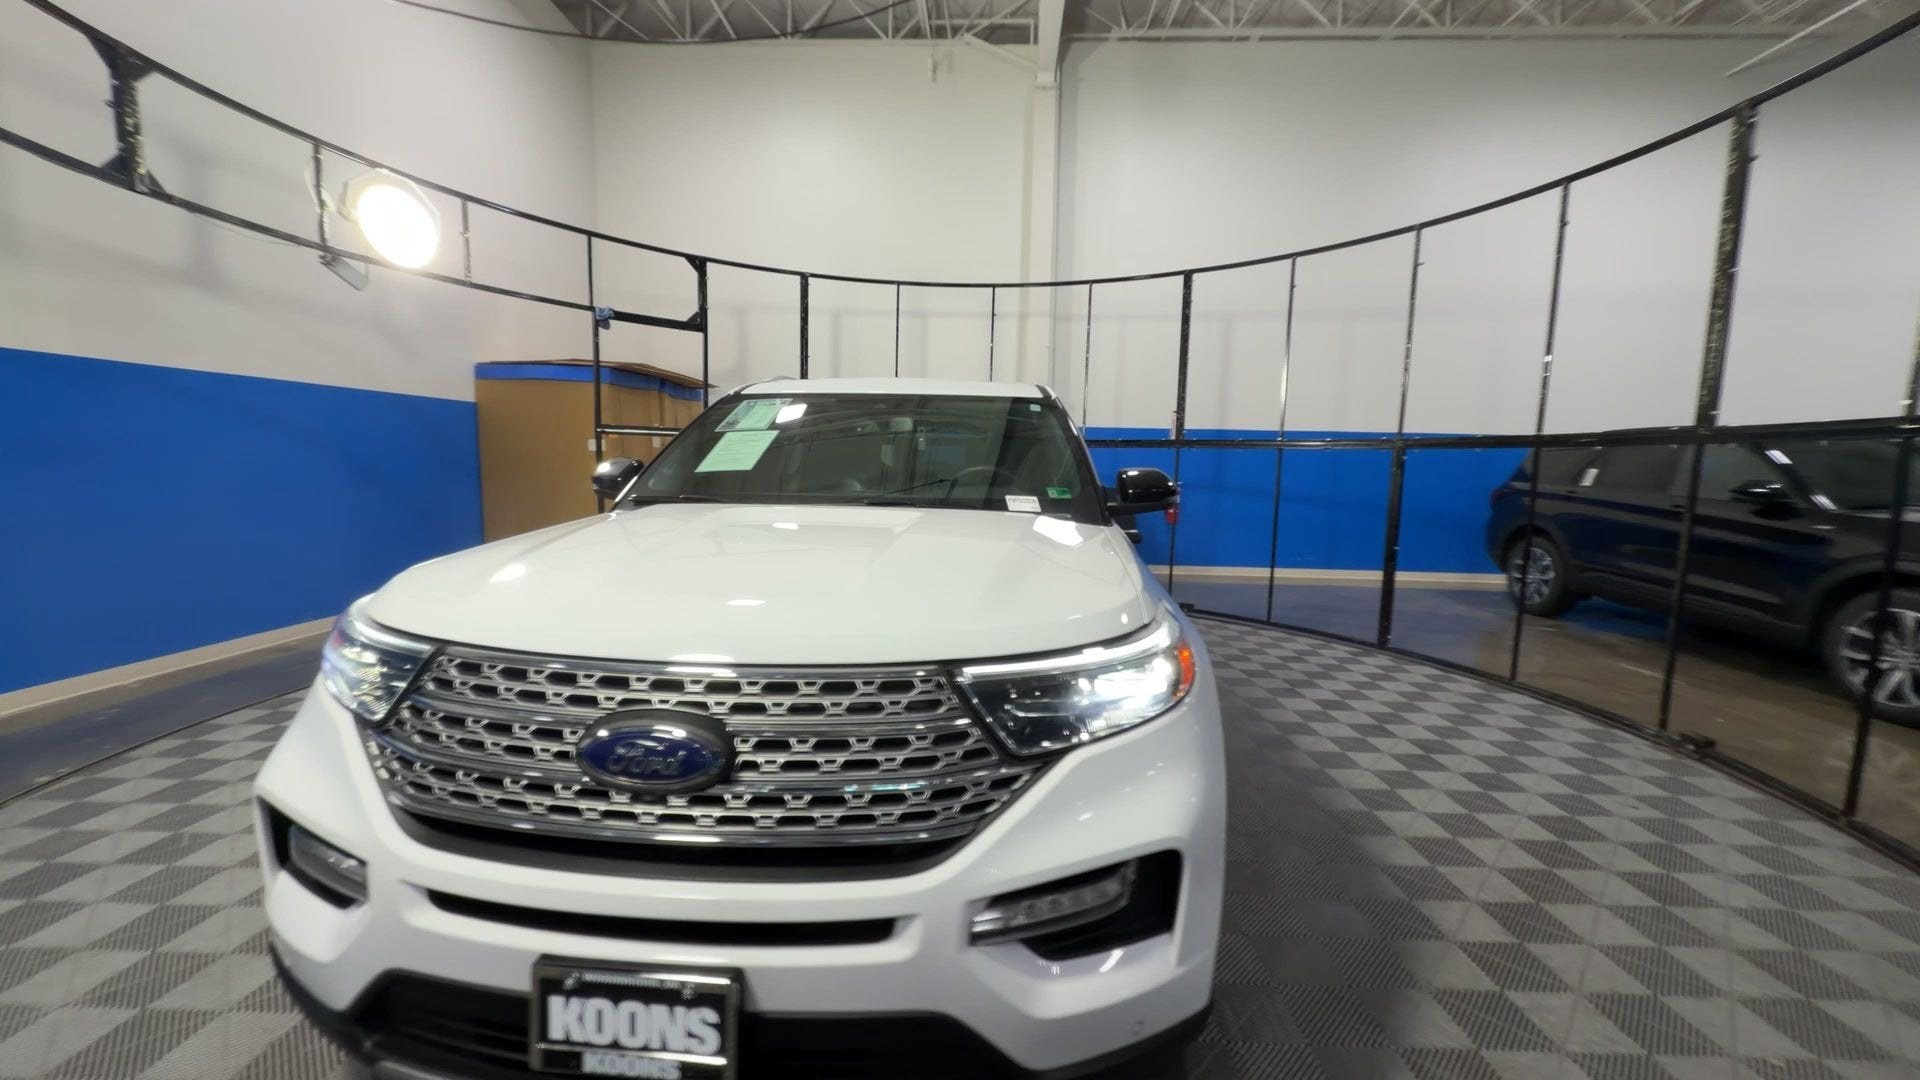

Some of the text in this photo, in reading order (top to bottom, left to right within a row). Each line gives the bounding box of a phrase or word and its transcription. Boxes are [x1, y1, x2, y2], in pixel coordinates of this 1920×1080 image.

[606, 739, 688, 775] Ford
[547, 995, 721, 1056] KOONS
[582, 1051, 682, 1080] KOONS
